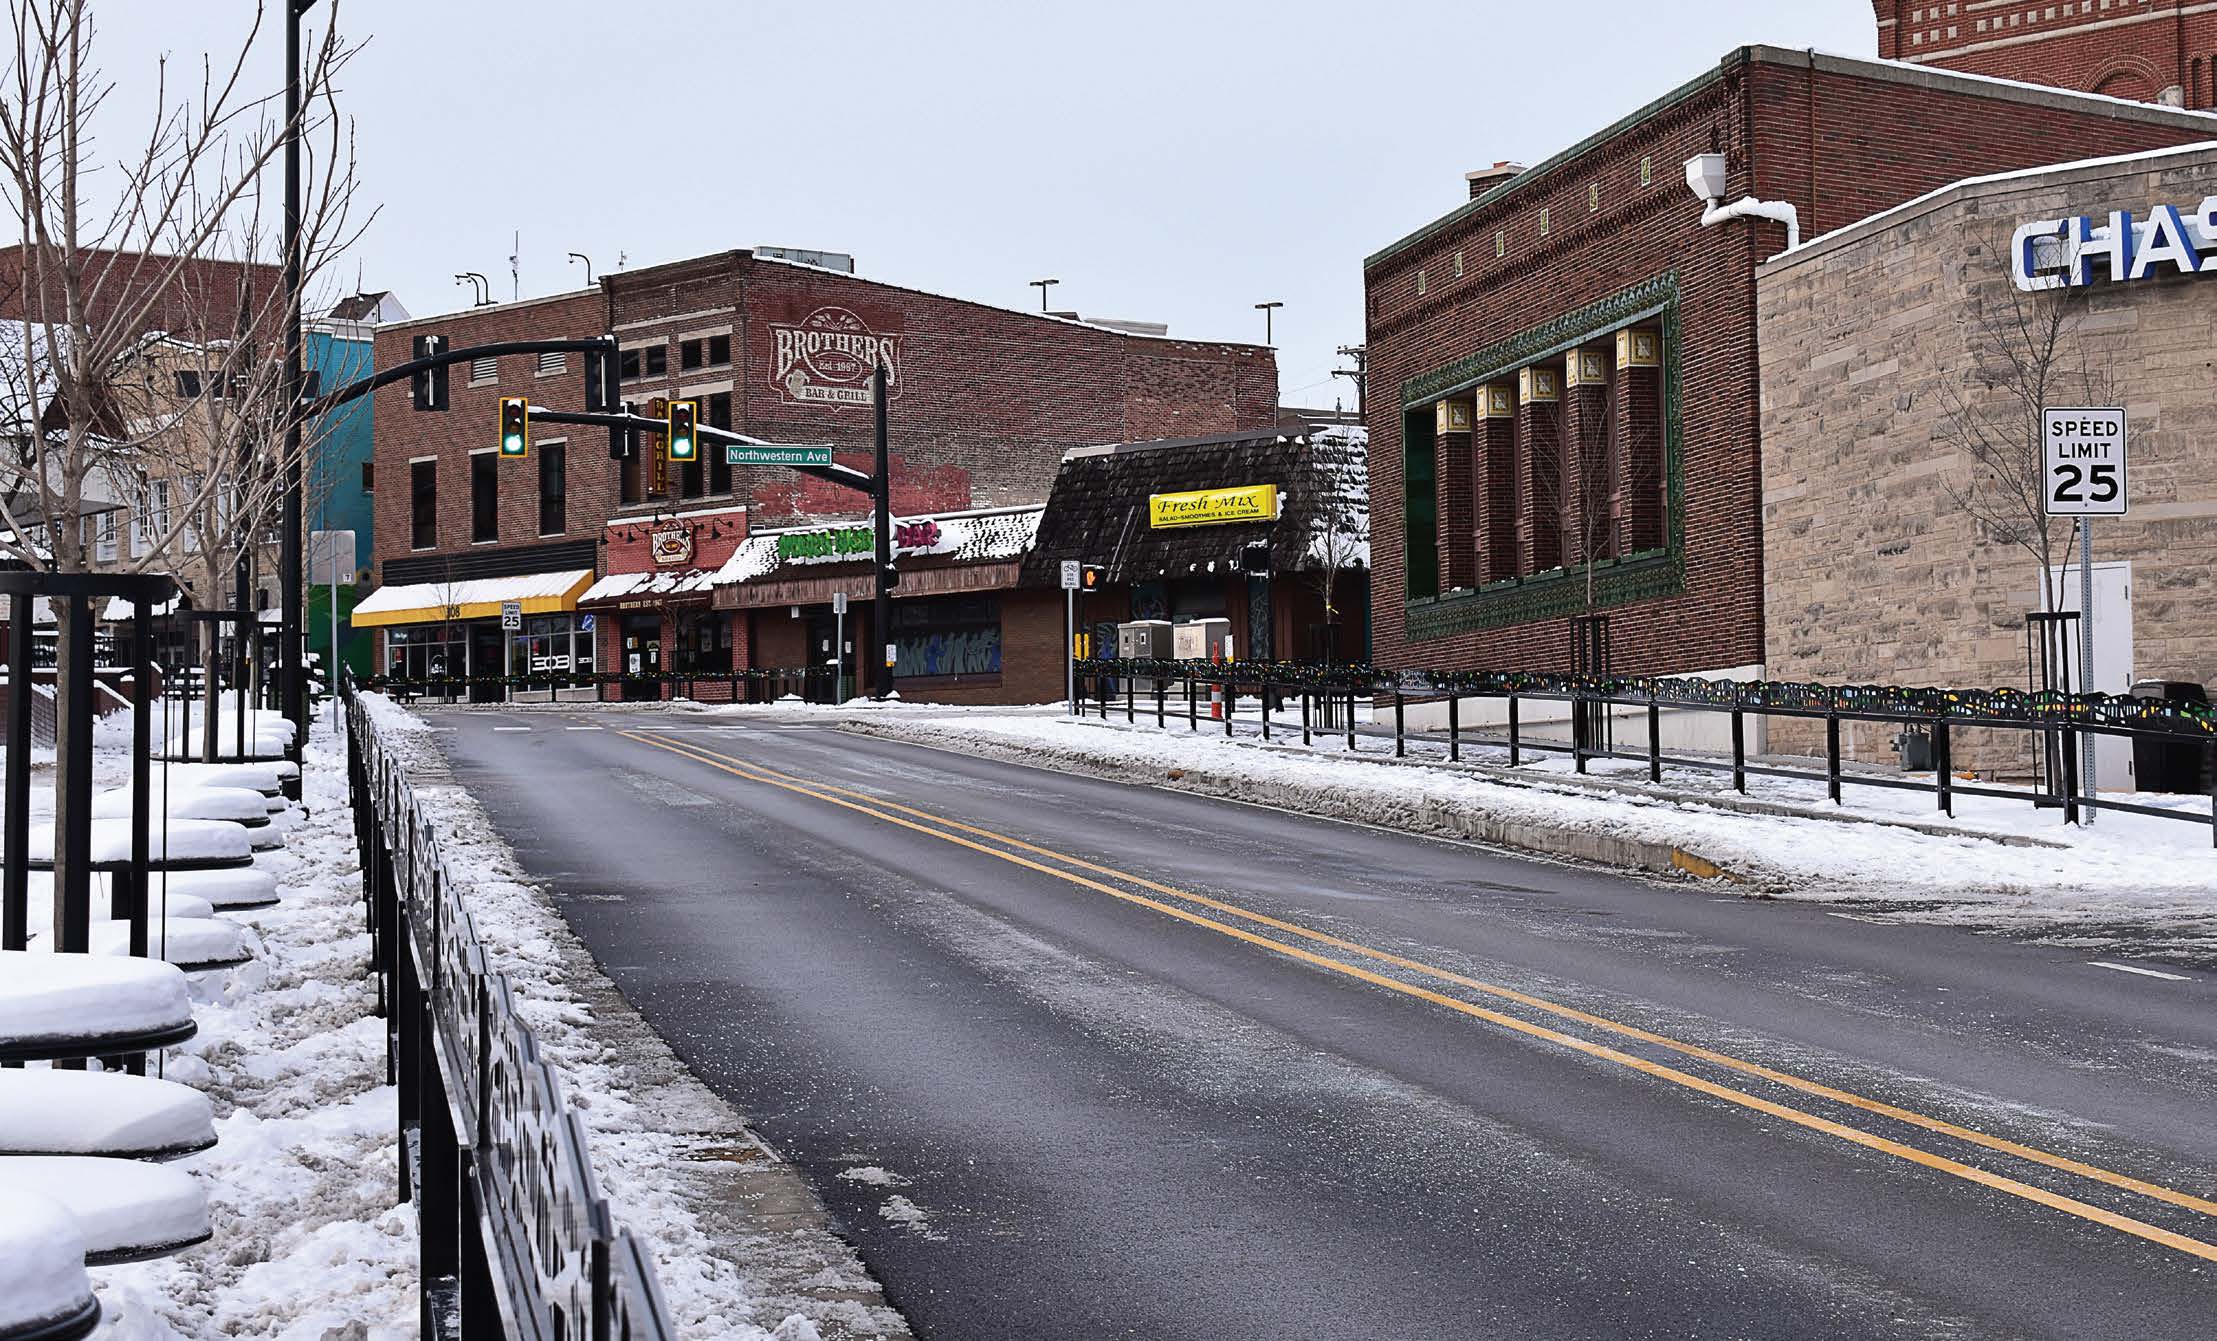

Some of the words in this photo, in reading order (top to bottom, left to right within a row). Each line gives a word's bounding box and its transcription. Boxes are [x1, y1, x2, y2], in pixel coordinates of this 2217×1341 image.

[776, 329, 895, 386] BROTHERS
[805, 388, 826, 399] BAR
[827, 389, 835, 399] &
[837, 390, 867, 401] GRILL
[2052, 421, 2118, 437] SPEED
[730, 449, 802, 461] Northwestern
[806, 451, 828, 462] Ave
[2058, 443, 2111, 458] LIMIT
[2053, 464, 2118, 502] 25
[1158, 495, 1209, 513] Fresh
[503, 616, 519, 627] 25
